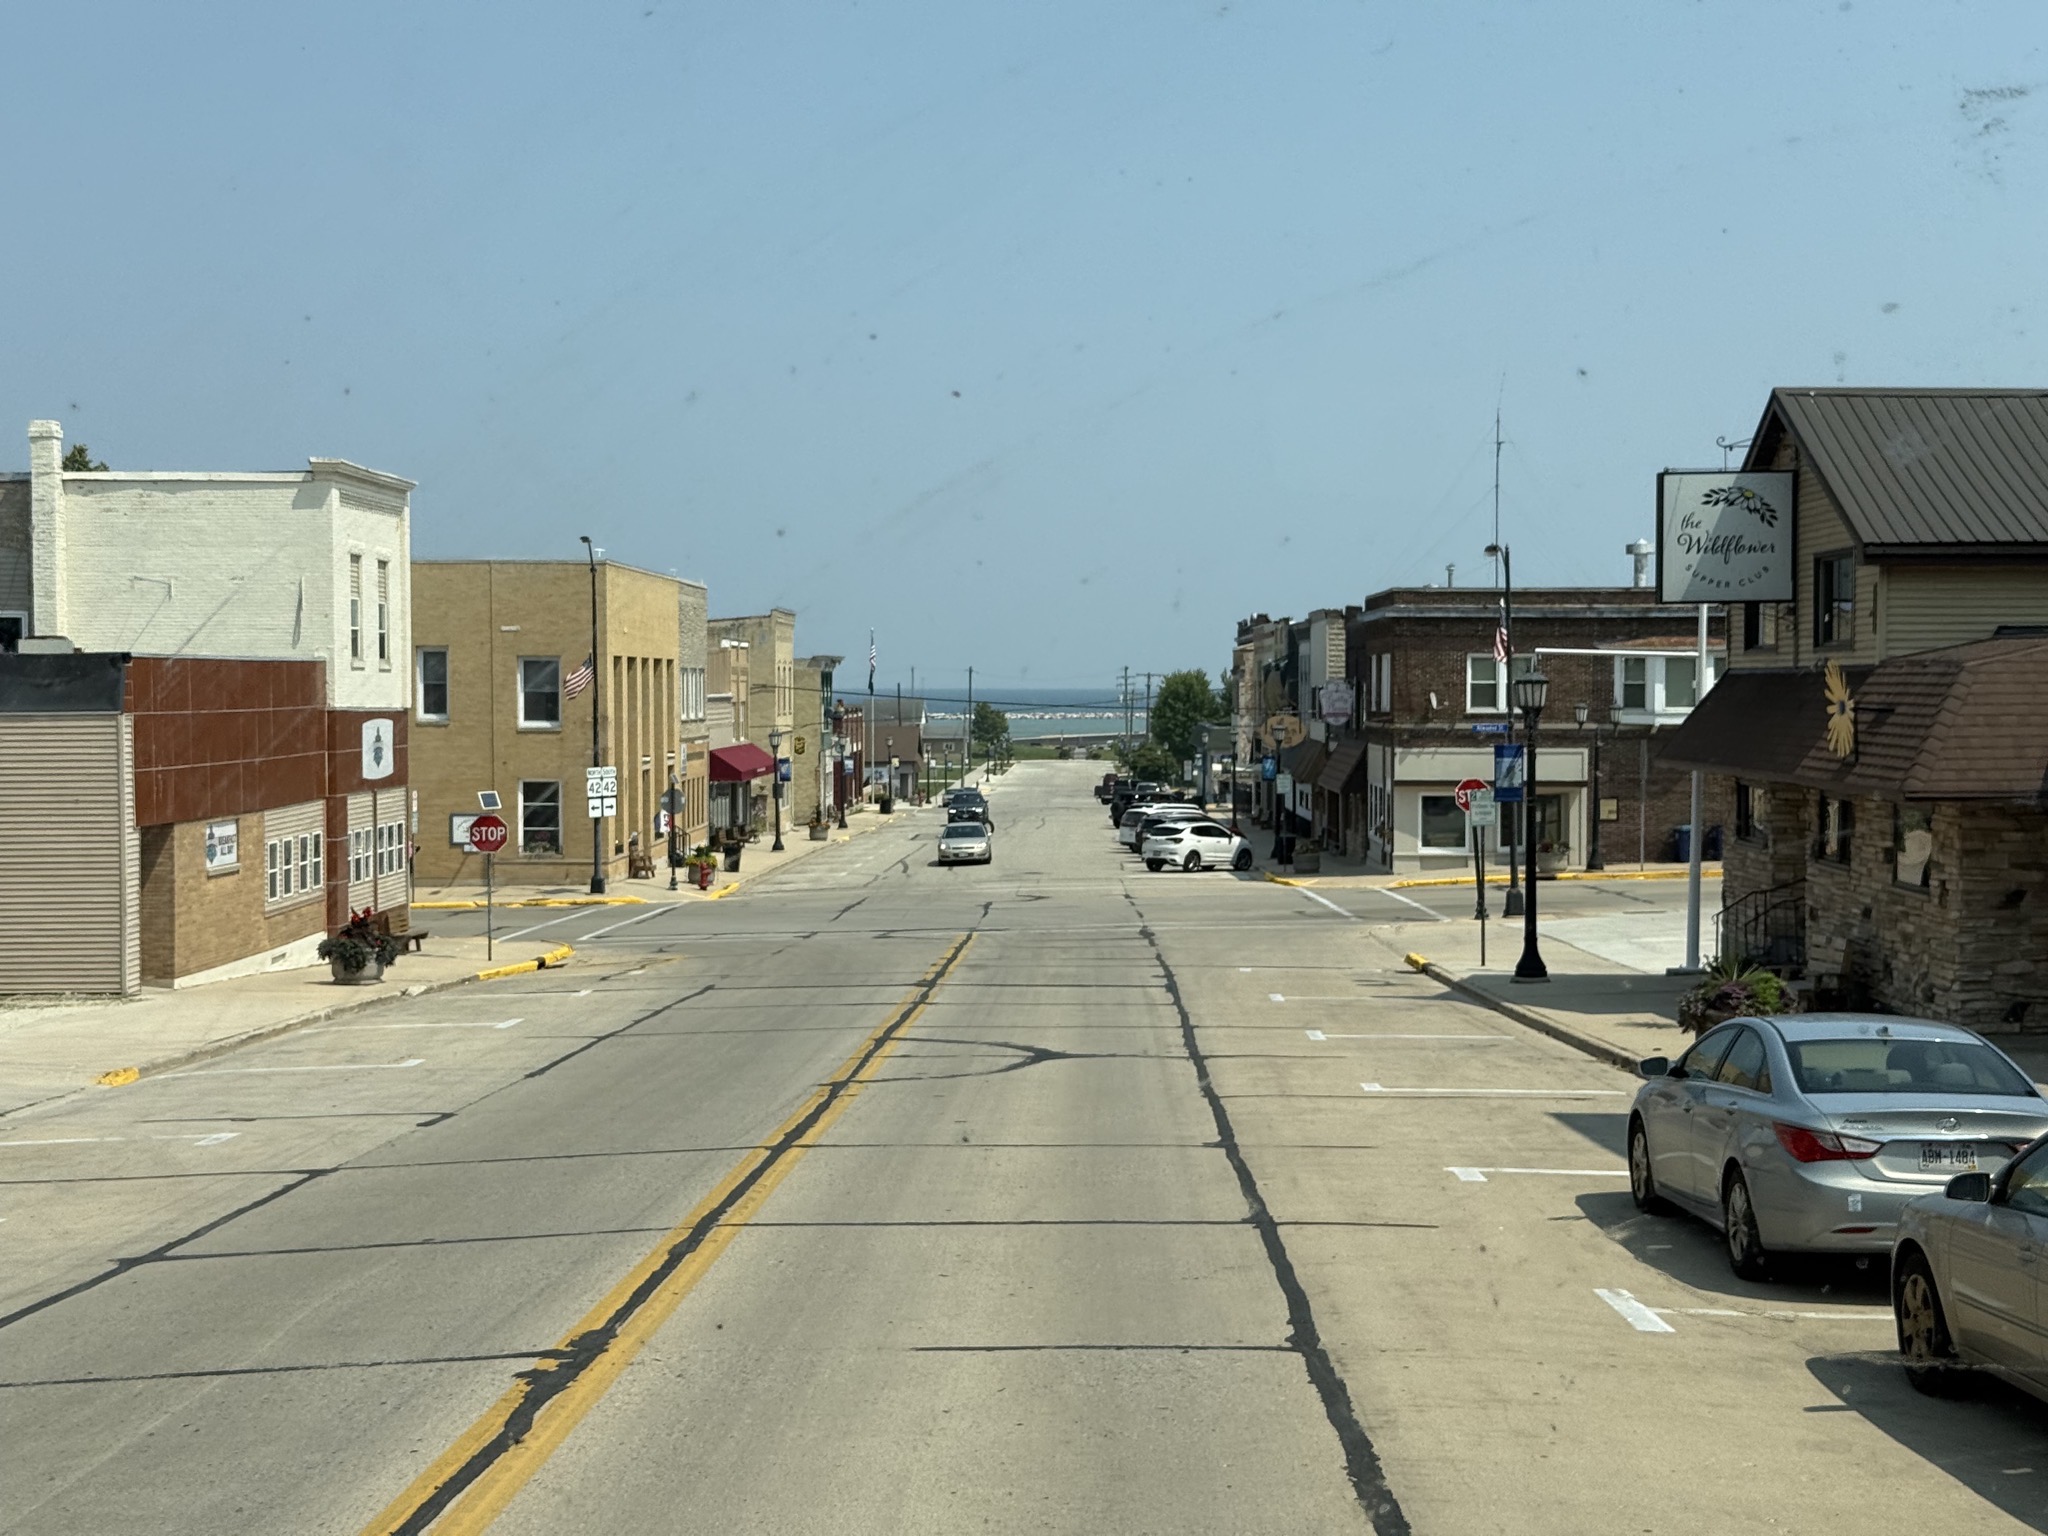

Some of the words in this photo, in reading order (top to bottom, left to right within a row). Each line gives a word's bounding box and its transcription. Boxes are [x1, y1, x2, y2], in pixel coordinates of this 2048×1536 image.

[1681, 512, 1702, 531] the
[1677, 530, 1776, 565] Wildflower
[1685, 564, 1730, 588] SUPPER
[1738, 566, 1769, 587] CLUB
[589, 782, 601, 793] 42
[604, 781, 616, 793] 42
[472, 826, 506, 842] STOP
